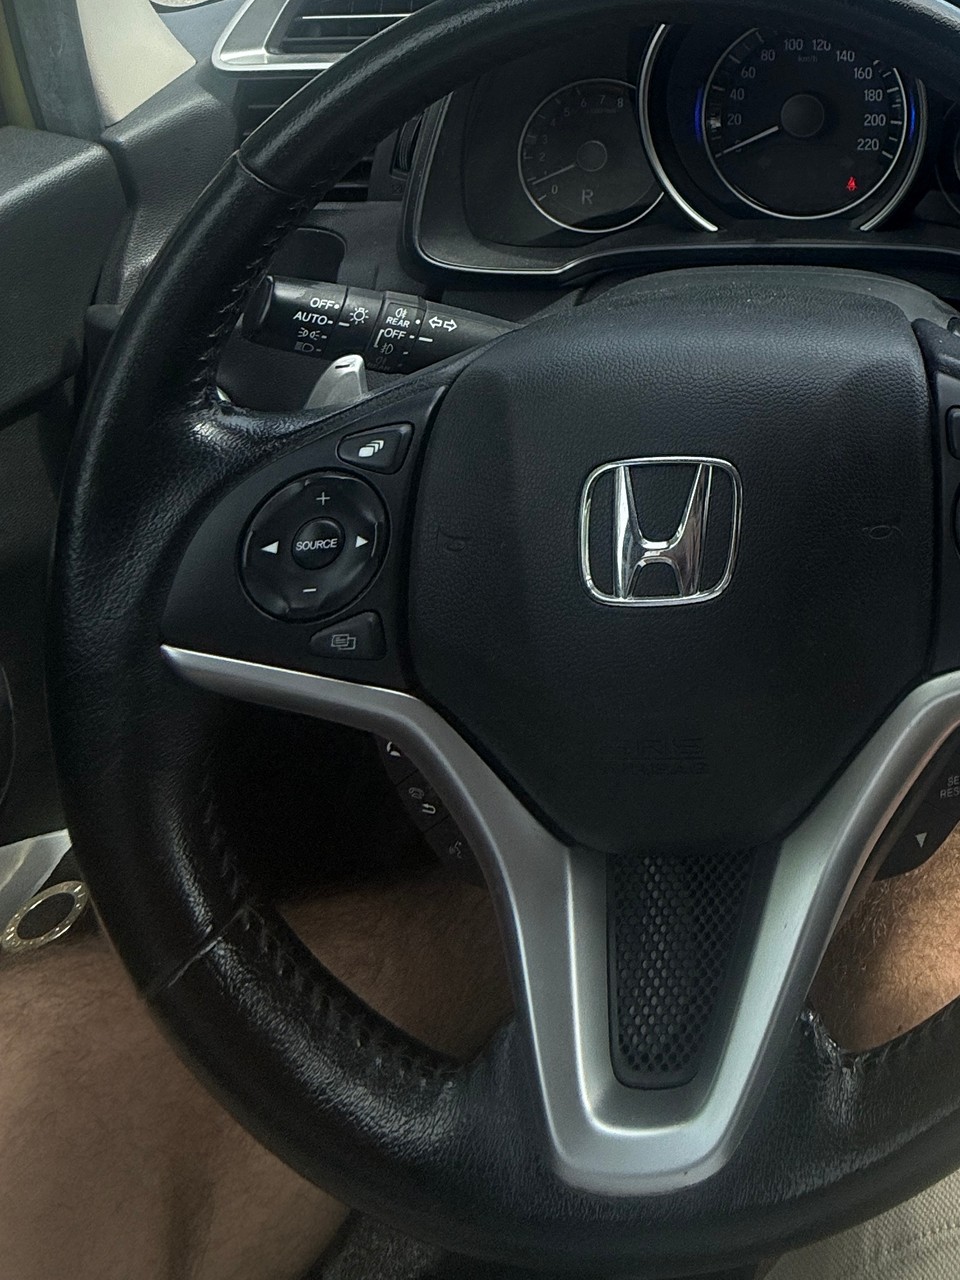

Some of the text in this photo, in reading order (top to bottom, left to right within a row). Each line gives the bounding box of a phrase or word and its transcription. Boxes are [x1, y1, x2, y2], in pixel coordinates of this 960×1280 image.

[784, 39, 803, 51] 100
[812, 39, 831, 51] 120
[760, 49, 775, 62] 80
[836, 50, 855, 62] 140
[741, 67, 756, 79] 60
[854, 67, 873, 79] 160
[730, 88, 745, 100] 40
[864, 89, 883, 102] 180
[617, 97, 624, 108] 8
[727, 113, 742, 125] 20
[864, 114, 886, 126] 200
[857, 138, 879, 151] 220
[581, 189, 594, 205] R
[310, 297, 335, 310] OFF
[293, 311, 328, 326] AUTO
[386, 316, 410, 328] REAR
[384, 328, 407, 340] OFF
[295, 538, 338, 551] SOURCE
